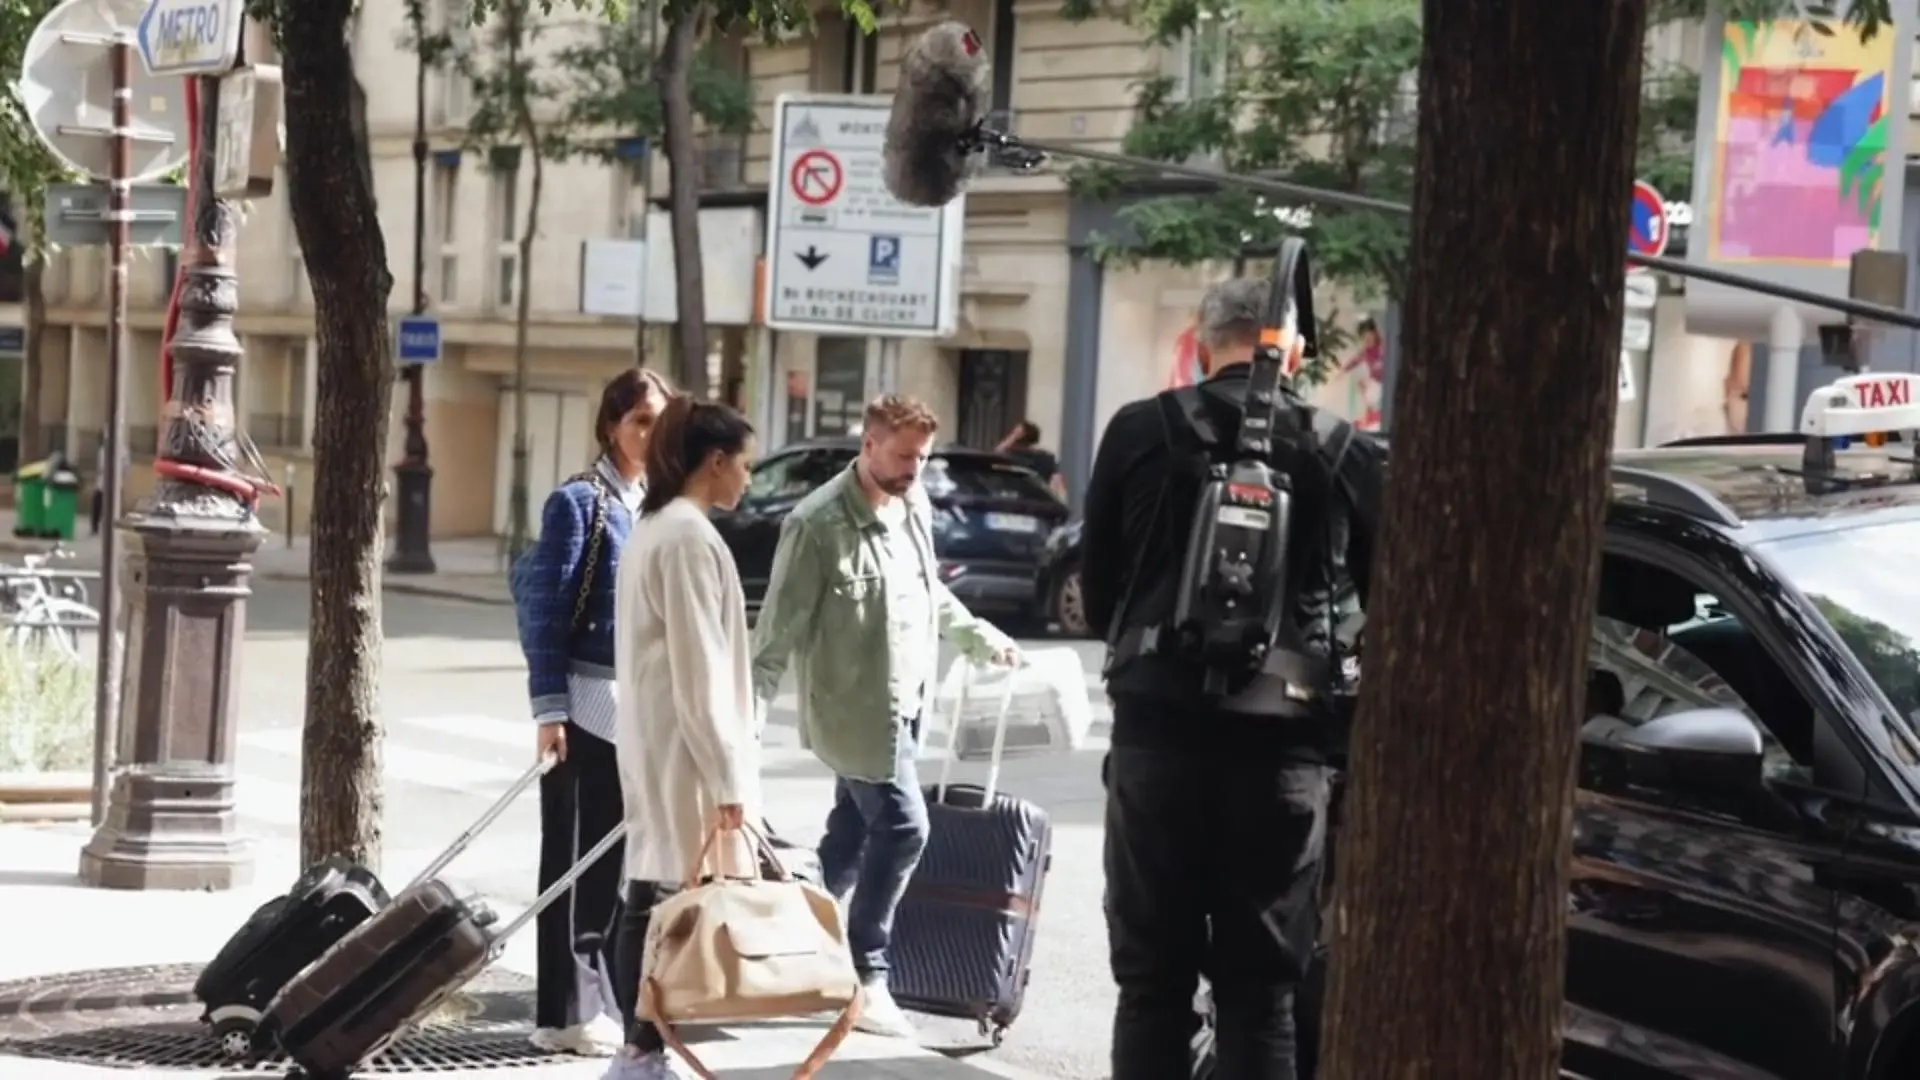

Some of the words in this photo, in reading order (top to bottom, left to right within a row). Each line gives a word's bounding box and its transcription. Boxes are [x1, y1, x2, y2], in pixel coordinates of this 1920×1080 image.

[838, 121, 884, 134] MONT
[806, 288, 928, 306] ROCHECHOUART
[862, 307, 917, 321] CLICHY
[1854, 379, 1910, 409] TAXI
